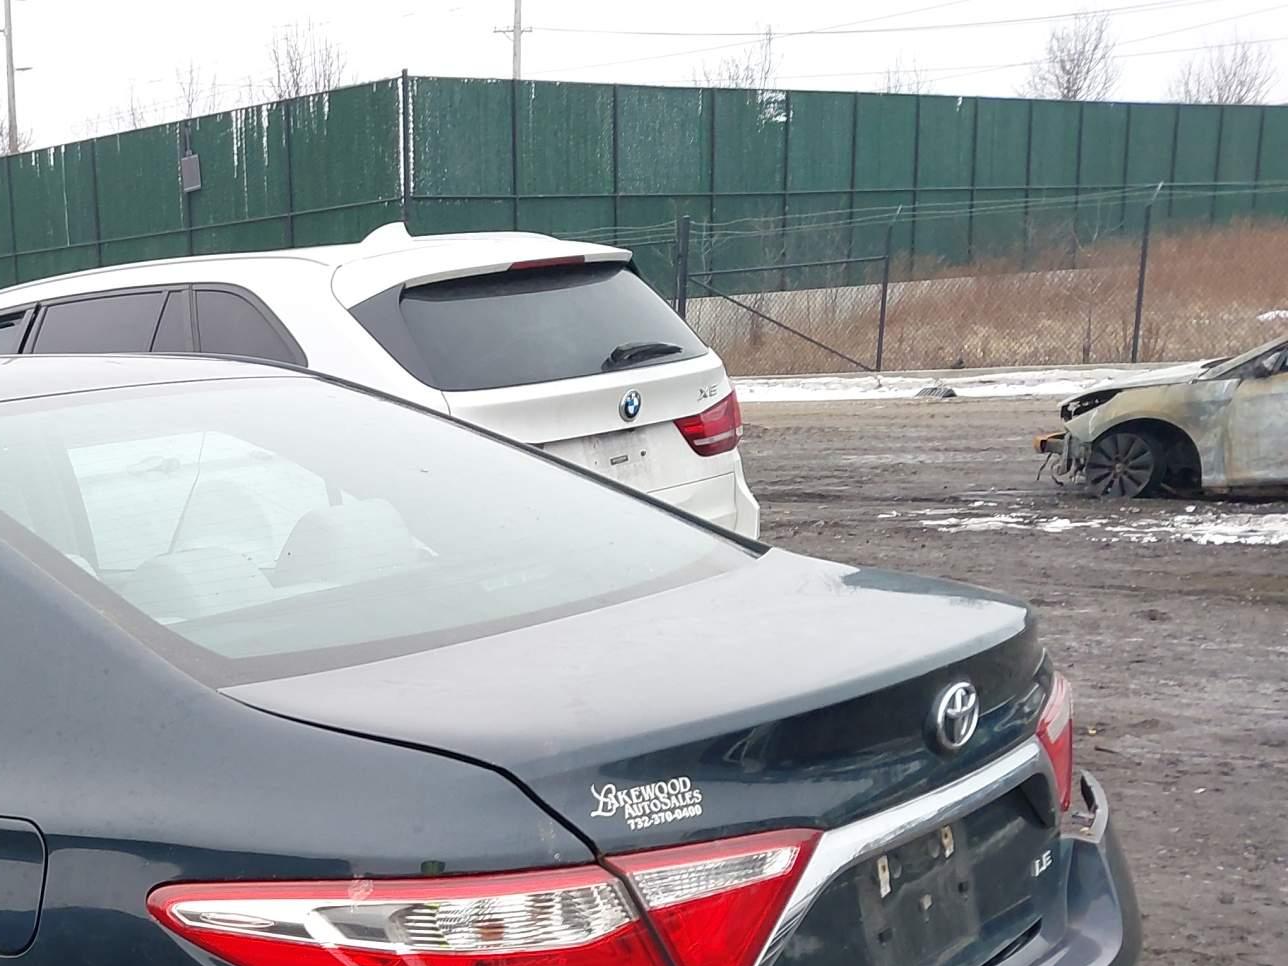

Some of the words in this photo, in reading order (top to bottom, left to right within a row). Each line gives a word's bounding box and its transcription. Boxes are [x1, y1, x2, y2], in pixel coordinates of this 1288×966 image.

[590, 776, 692, 818] LAKEWOOD
[627, 804, 703, 831] 732-370-0400
[1033, 850, 1053, 877] LE
